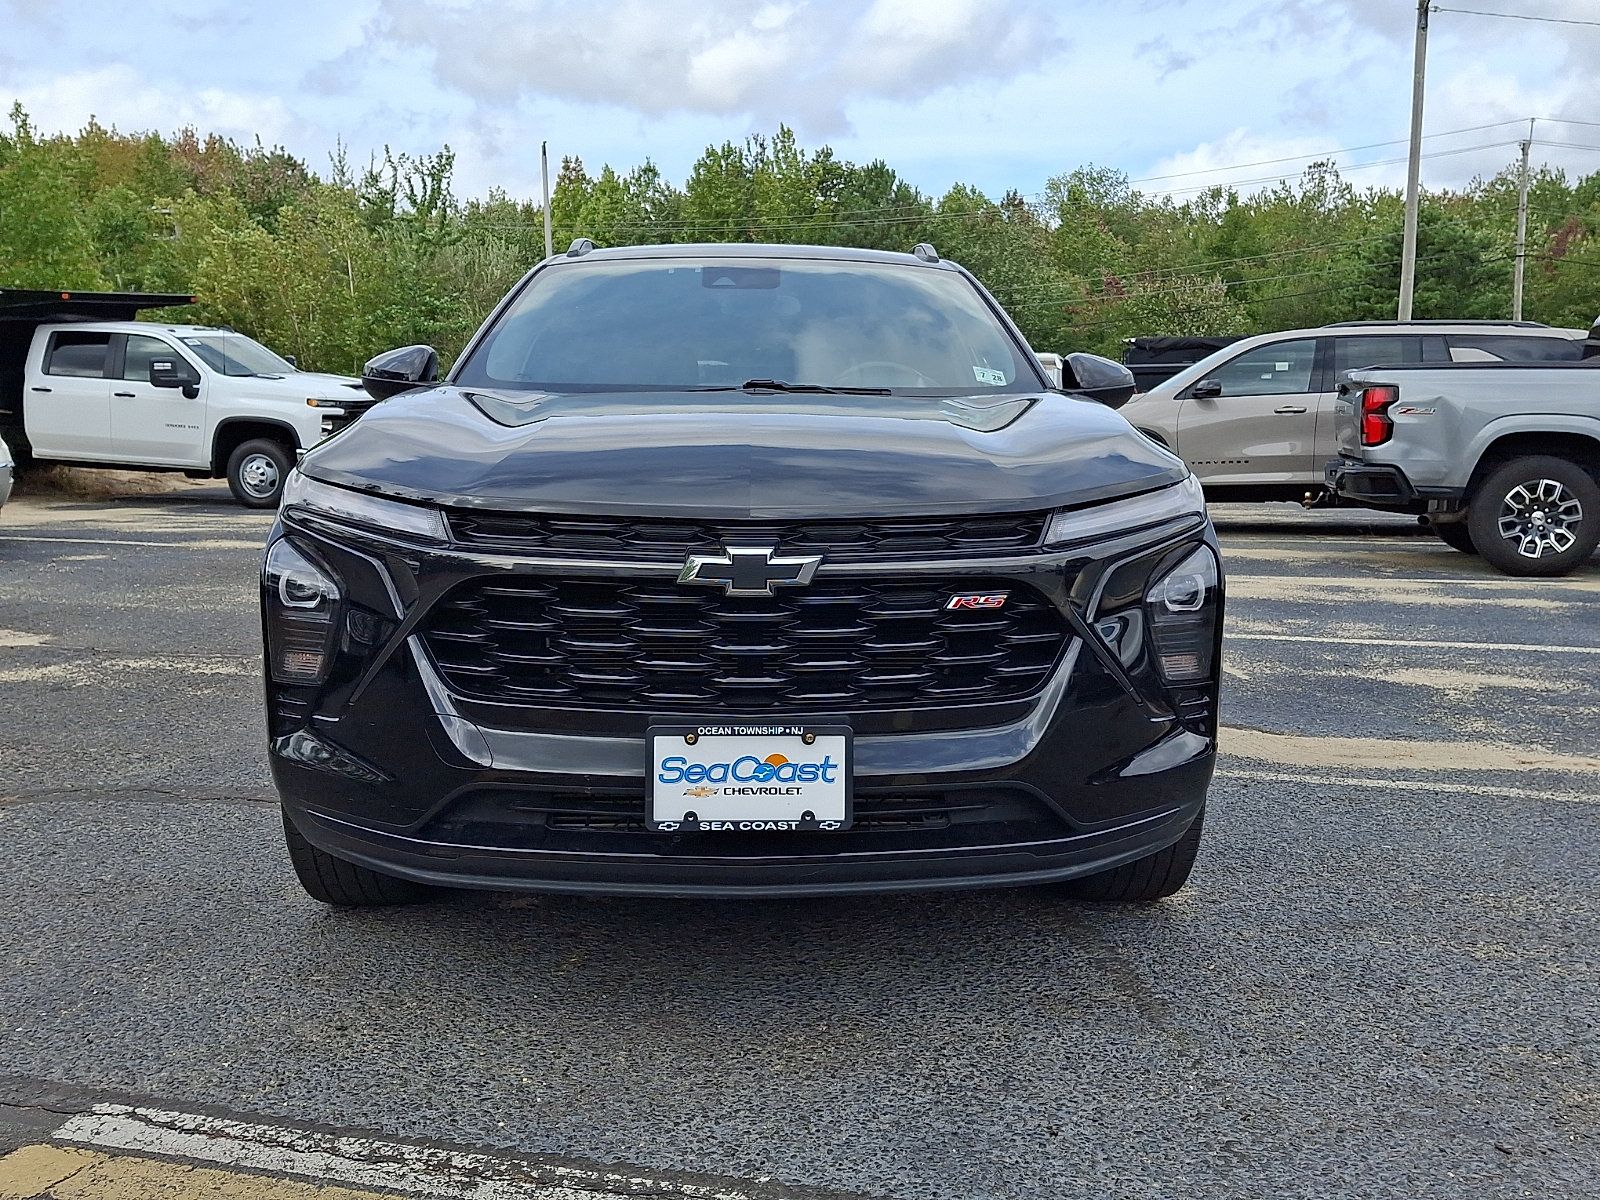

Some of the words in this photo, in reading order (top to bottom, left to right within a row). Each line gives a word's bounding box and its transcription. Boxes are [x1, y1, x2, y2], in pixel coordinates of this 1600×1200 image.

[946, 594, 1008, 610] RS
[697, 726, 732, 735] OCEAN
[733, 726, 784, 735] TOWNSHIP
[791, 726, 804, 735] NJ
[723, 786, 803, 796] CHEVROLET
[699, 821, 735, 831] SEA
[739, 821, 800, 831] COAST
